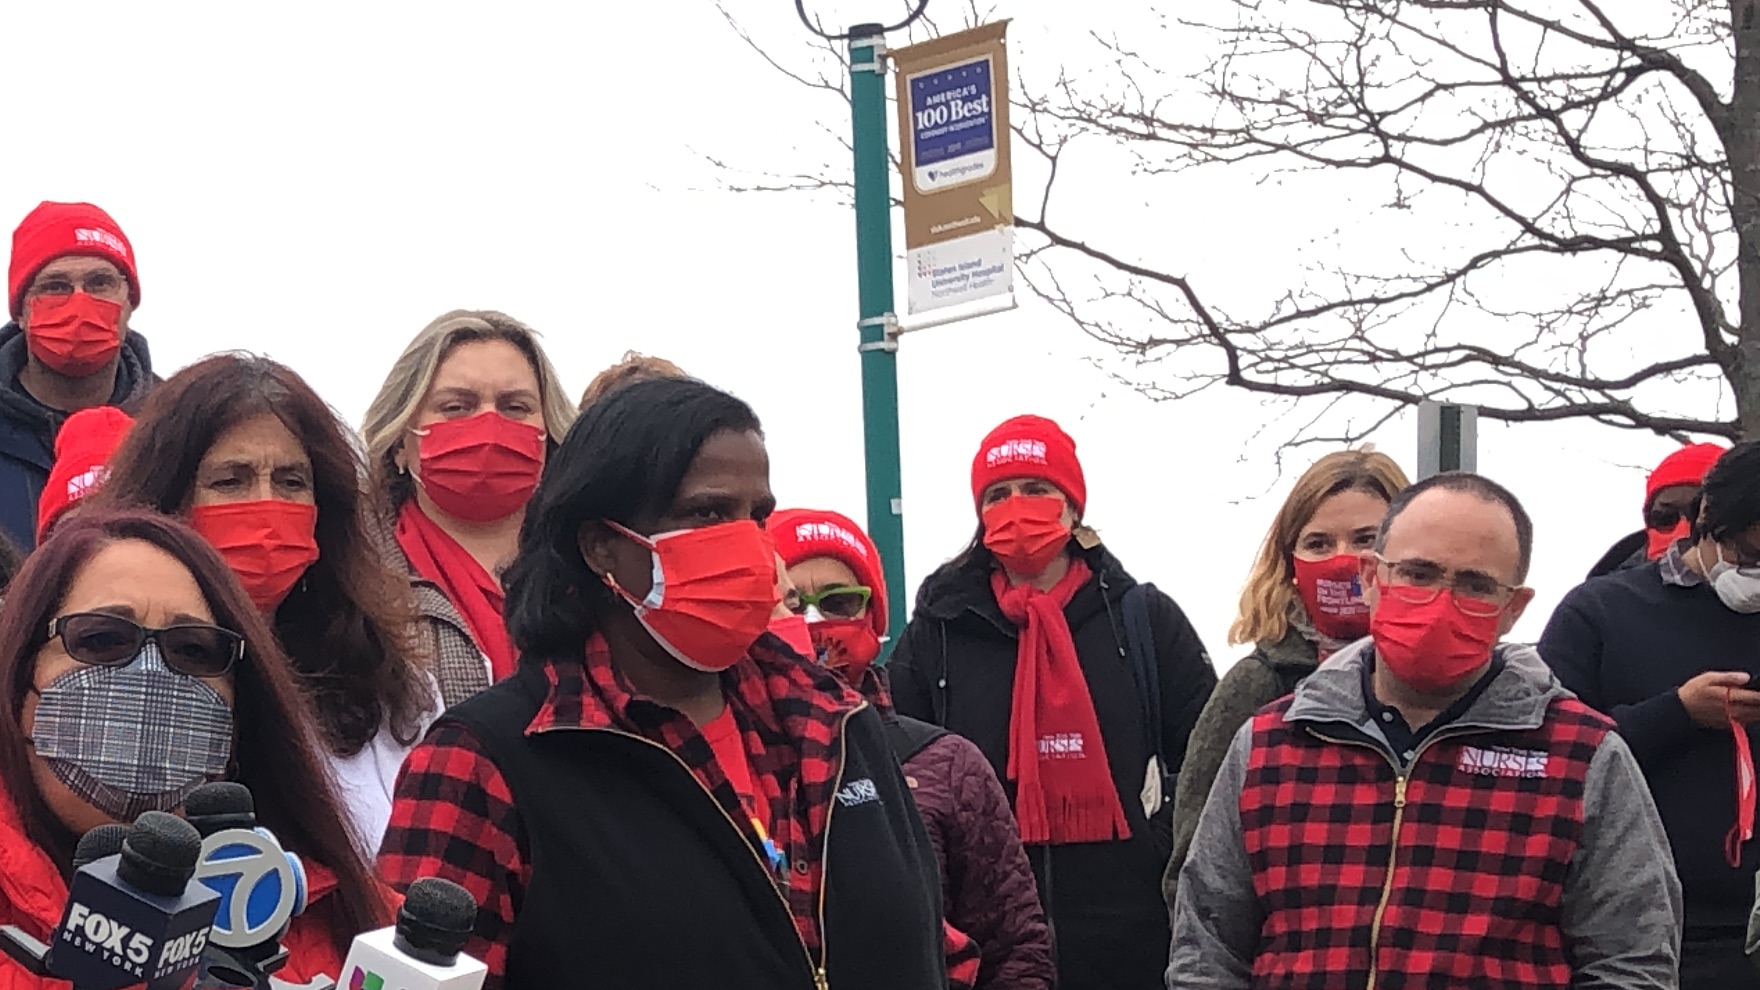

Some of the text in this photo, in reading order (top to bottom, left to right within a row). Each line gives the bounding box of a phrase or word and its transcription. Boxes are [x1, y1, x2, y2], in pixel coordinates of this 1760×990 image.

[915, 105, 948, 130] 100
[949, 93, 990, 121] Best
[1459, 746, 1549, 771] NURSES
[62, 930, 144, 978] NEW YORK
